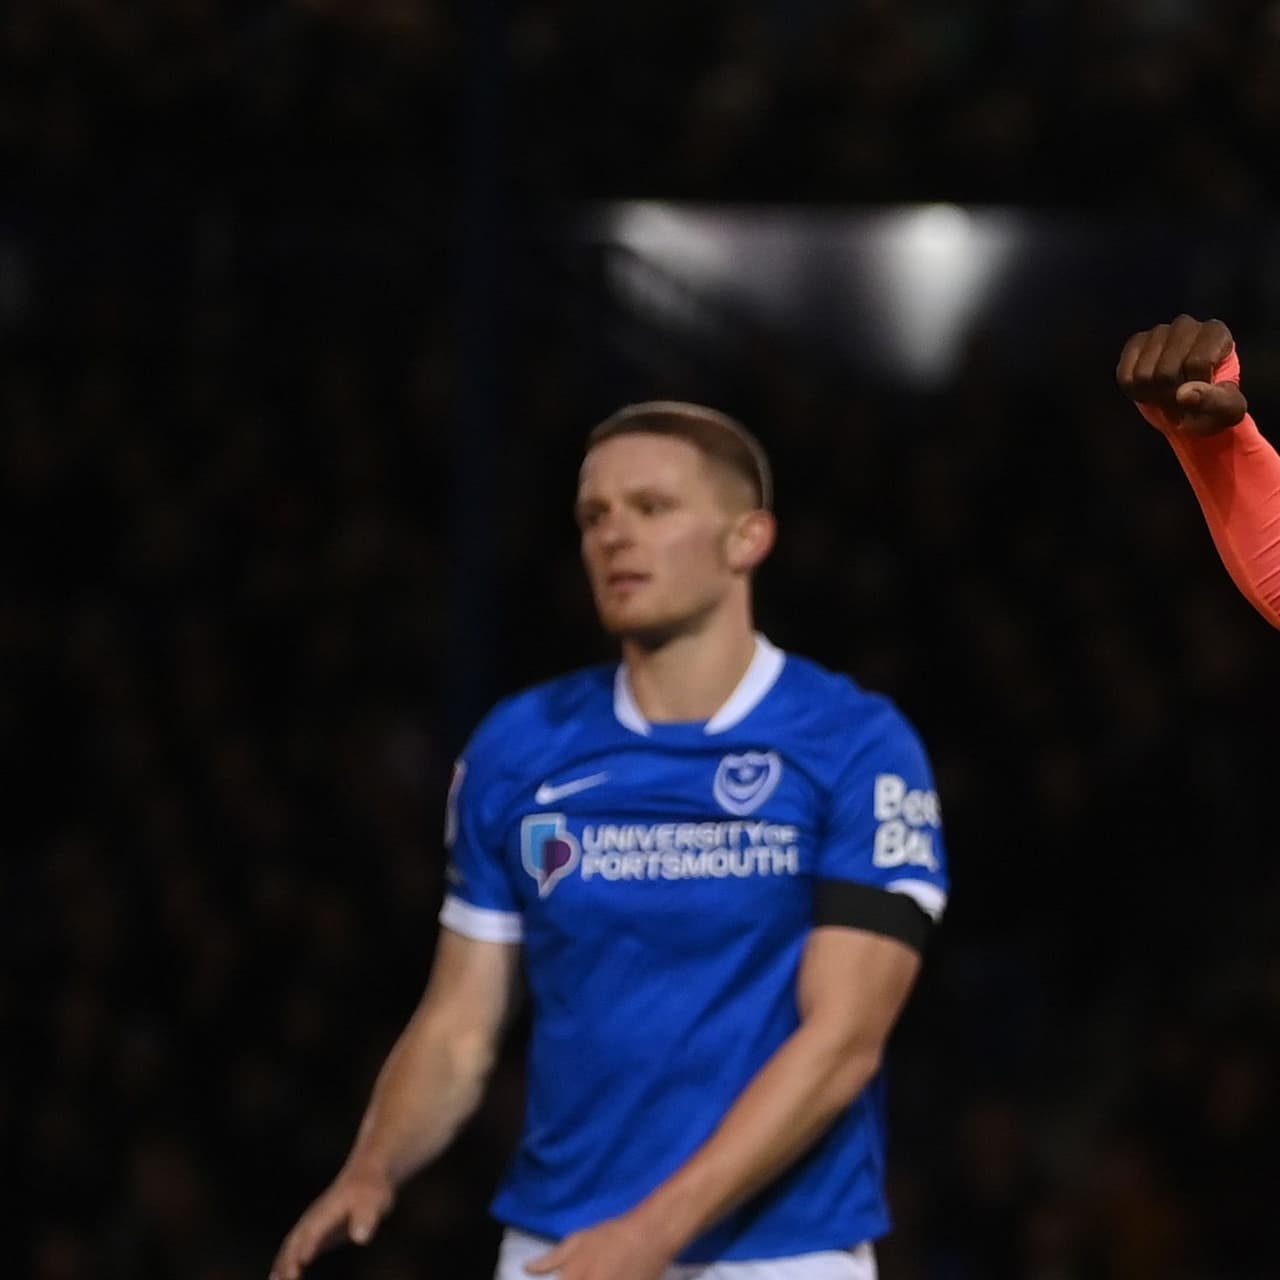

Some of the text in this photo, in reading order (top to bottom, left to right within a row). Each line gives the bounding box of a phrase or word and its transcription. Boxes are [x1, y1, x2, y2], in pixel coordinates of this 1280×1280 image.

[581, 820, 800, 851] UNIVERSITY OF
[580, 845, 800, 882] PORTSMOUTH
